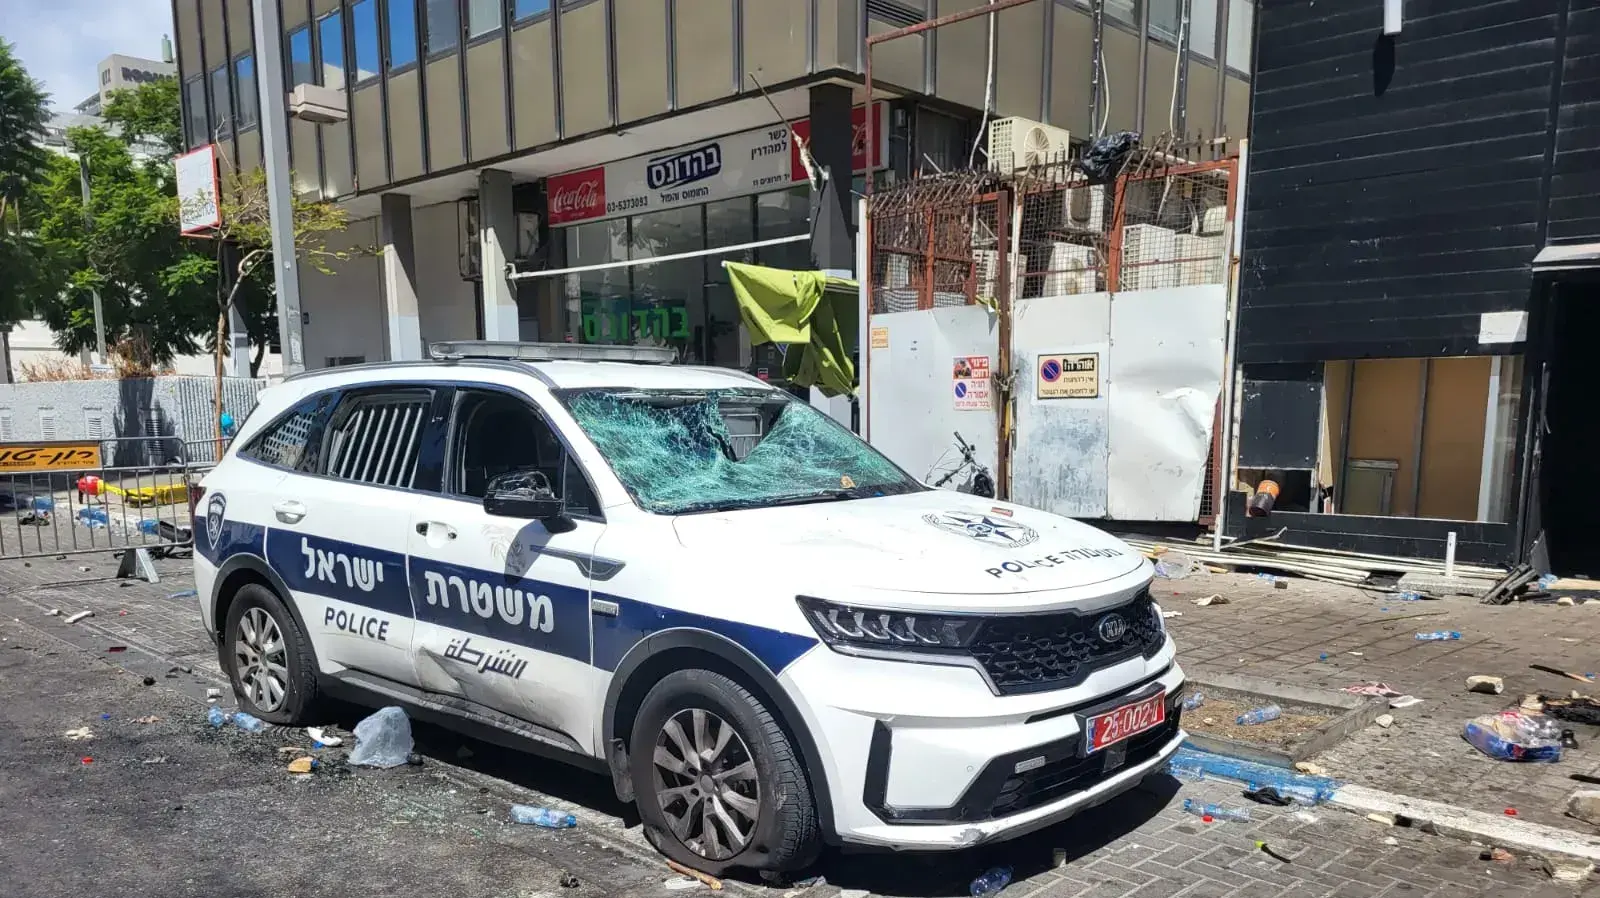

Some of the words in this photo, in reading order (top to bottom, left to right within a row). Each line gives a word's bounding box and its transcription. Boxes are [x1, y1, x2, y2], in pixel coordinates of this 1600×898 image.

[767, 129, 788, 141] כשר
[751, 140, 788, 161] למהדרין
[651, 147, 720, 187] בהדונס
[607, 195, 648, 213] 03-5373093
[682, 186, 709, 199] החומוס
[583, 306, 691, 343] בהדונס
[301, 537, 385, 592] ישראל
[984, 555, 1064, 579] POLICE
[424, 569, 555, 634] משטרת
[324, 606, 390, 642] POLICE
[1105, 619, 1126, 639] KIA
[444, 637, 529, 680] الشرطة
